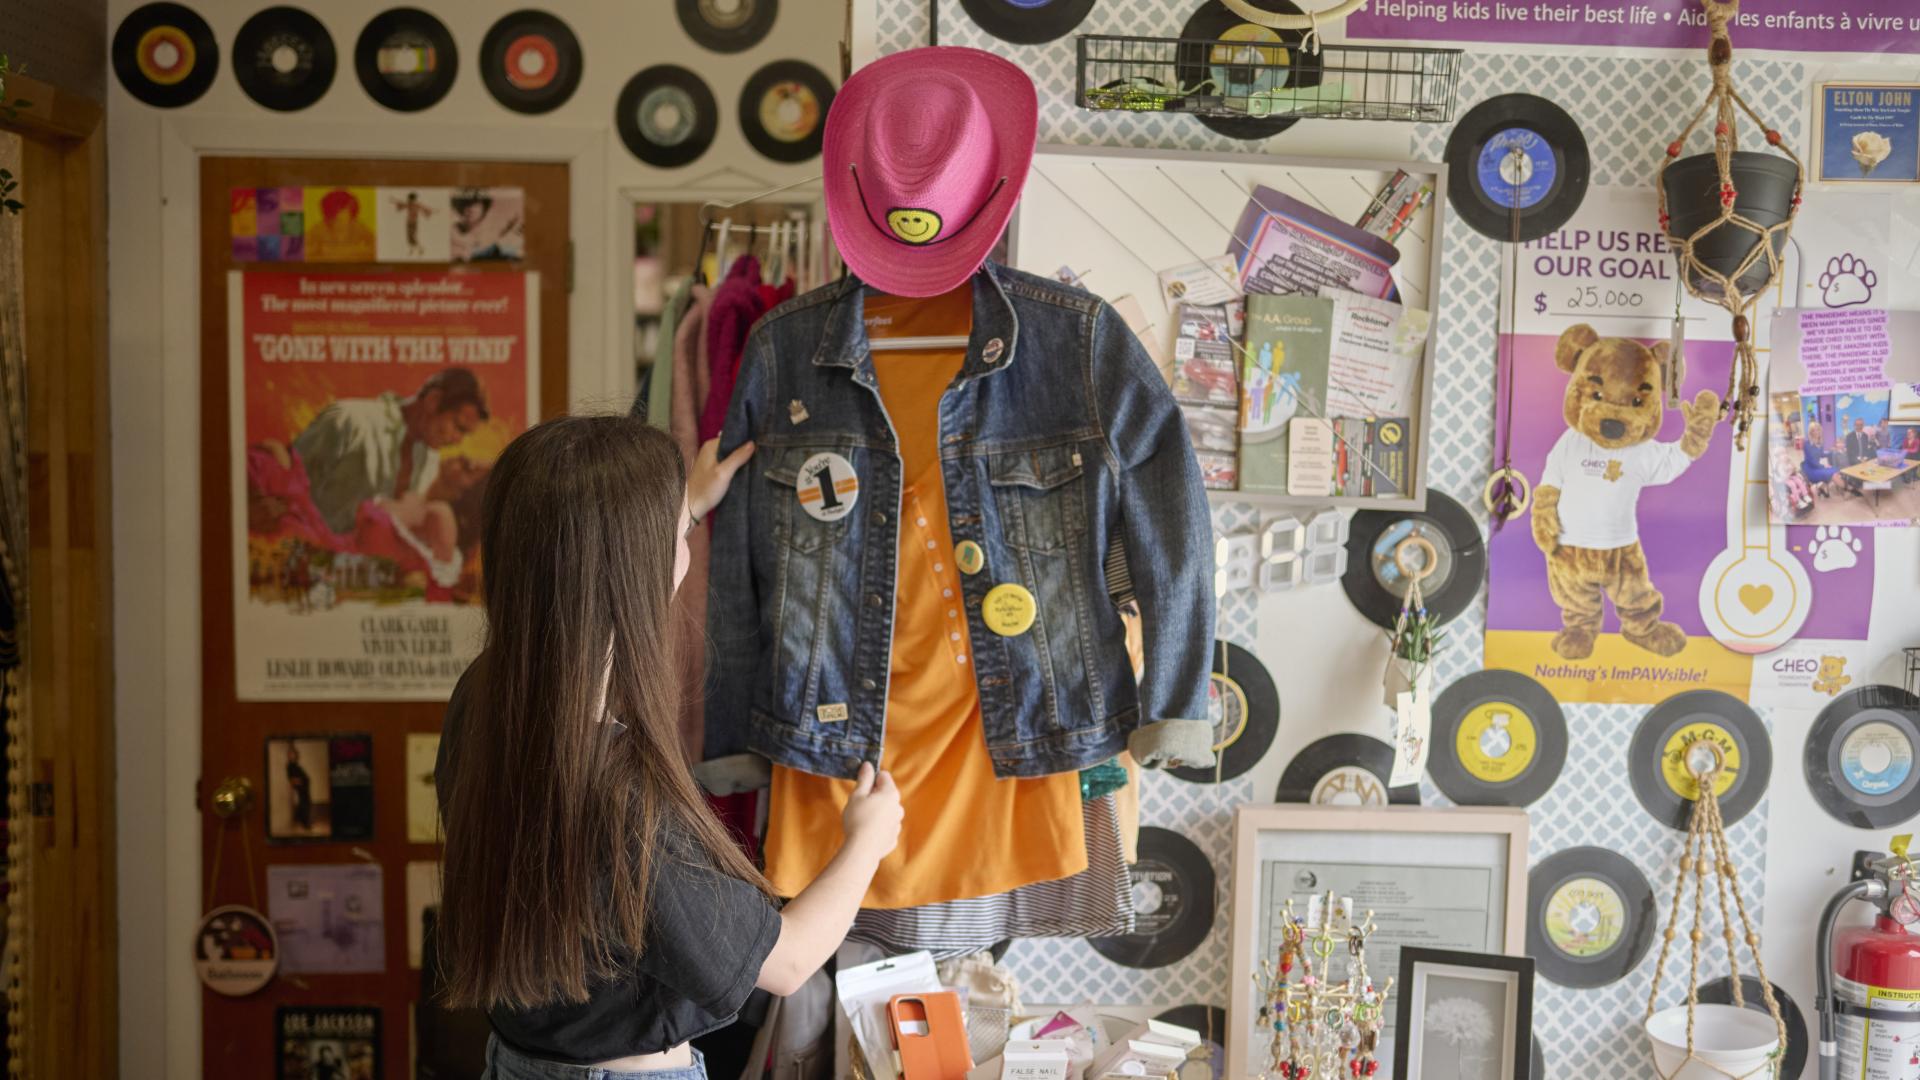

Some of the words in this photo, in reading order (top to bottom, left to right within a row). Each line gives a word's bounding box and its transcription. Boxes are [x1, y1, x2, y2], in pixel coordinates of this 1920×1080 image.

[1374, 0, 1448, 22] Helping
[1453, 1, 1490, 20] kids
[1496, 2, 1528, 21] live
[1534, 3, 1579, 22] their
[1584, 4, 1625, 24] best
[1629, 6, 1657, 25] life
[1734, 10, 1760, 27] les
[1764, 10, 1835, 30] enfants
[1840, 13, 1852, 30] à
[1856, 14, 1904, 31] vivre
[1834, 91, 1873, 106] ELTON
[1878, 92, 1912, 106] JOHN
[1597, 231, 1629, 252] US
[1637, 232, 1674, 254] RE
[1533, 255, 1593, 278] OUR
[1598, 257, 1671, 280] GOAL
[299, 279, 315, 295] In
[319, 281, 346, 295] new
[350, 281, 396, 295] screen
[262, 295, 288, 313] The
[292, 298, 326, 313] most
[331, 295, 416, 315] magnificent
[419, 297, 468, 316] picture
[472, 296, 508, 313] ever!
[1533, 291, 1547, 314] $
[1282, 314, 1312, 326] Group
[1351, 312, 1389, 328] Rockland
[1815, 311, 1848, 319] PANDEMIC
[1839, 318, 1866, 326] MONTHS
[330, 335, 391, 363] WITH
[395, 335, 443, 363] THE
[1831, 359, 1869, 367] SUPPORTING
[1810, 368, 1847, 376] INCREDIBLE
[1581, 459, 1606, 469] CHEO
[813, 465, 843, 511] 1
[360, 617, 405, 634] CLARK
[407, 617, 449, 634] GABLE
[361, 638, 409, 655] VIVIEN
[412, 639, 452, 655] LEIGH
[266, 658, 313, 679] LESLIE
[318, 658, 375, 679] HOWARD
[379, 658, 424, 678] OLIVIA
[1534, 663, 1608, 682] Nothing's
[1611, 666, 1708, 682] ImPAWsible!
[1772, 657, 1818, 673] CHEO
[207, 967, 263, 980] Bathroom
[284, 1013, 309, 1032] JOE
[315, 1013, 375, 1032] JACKSON
